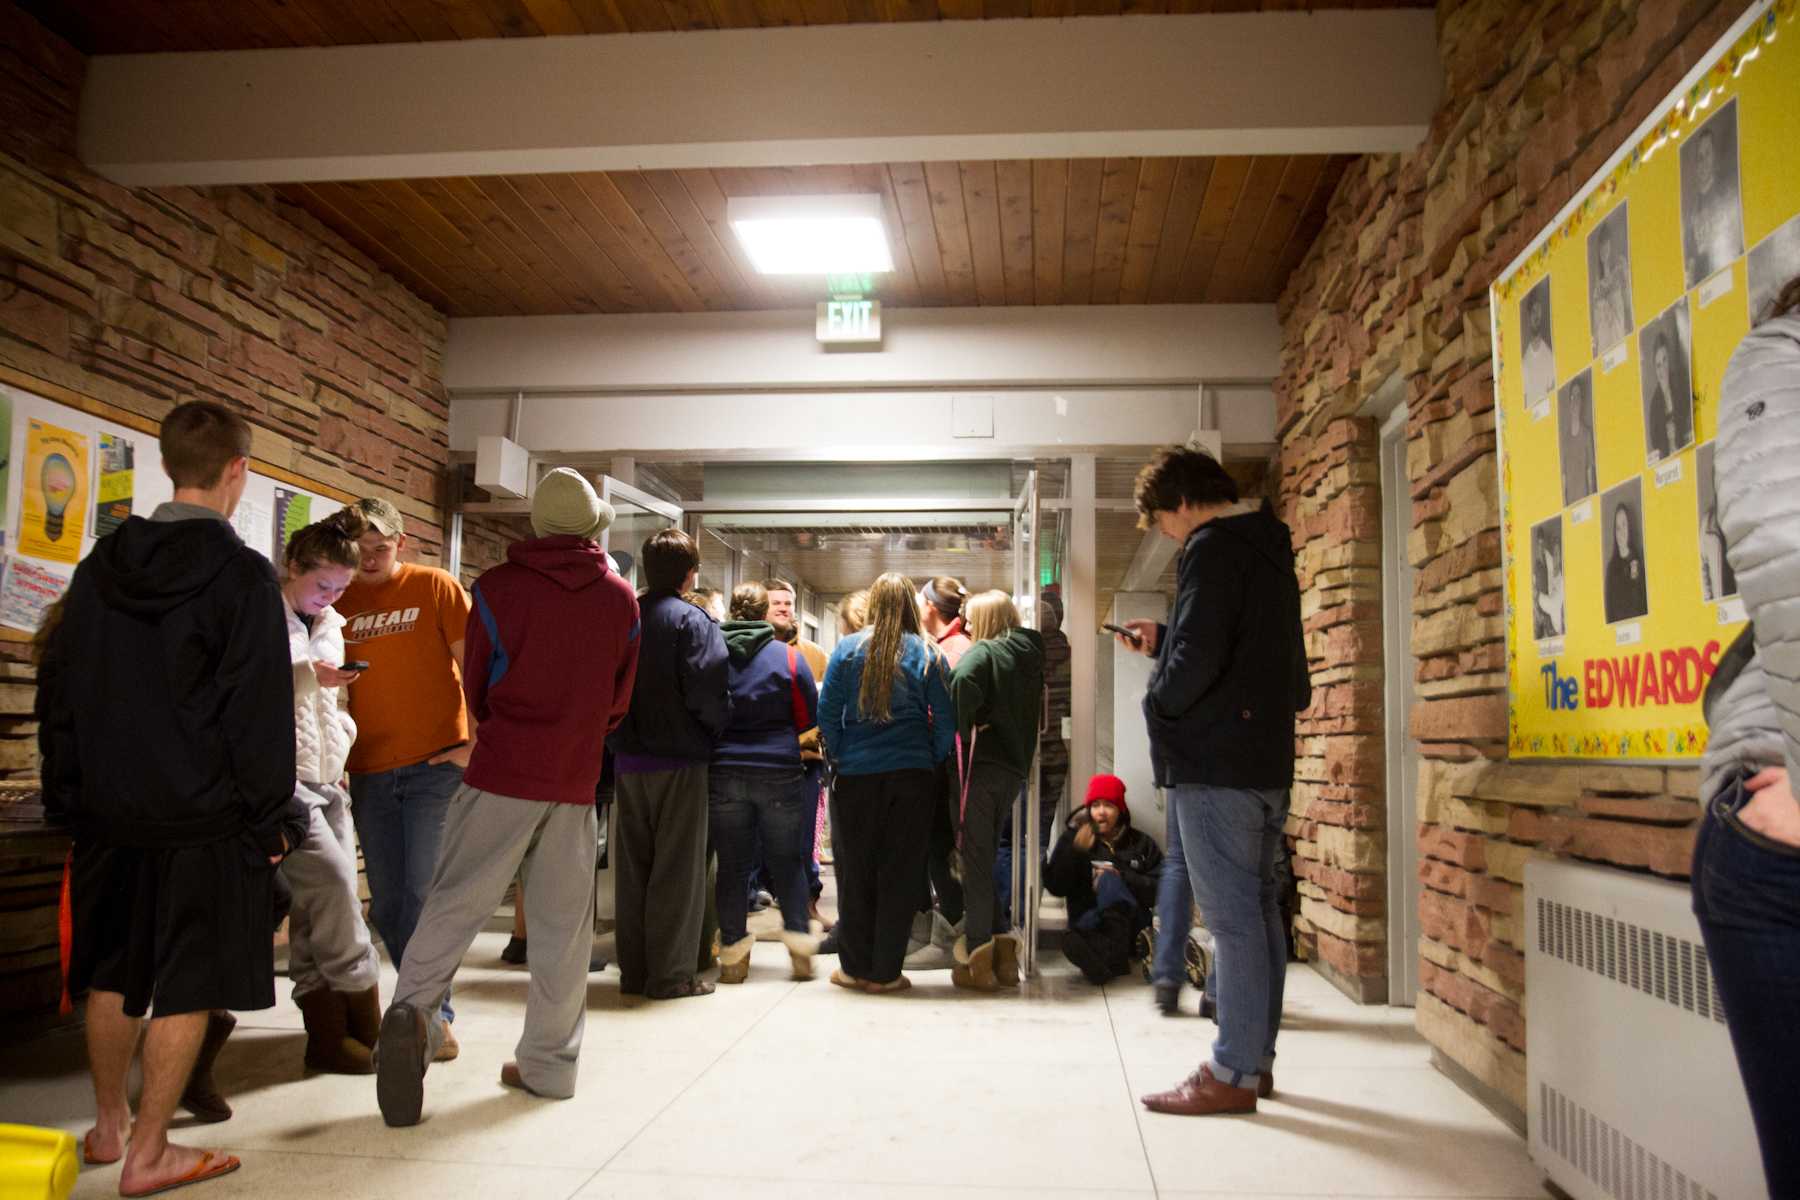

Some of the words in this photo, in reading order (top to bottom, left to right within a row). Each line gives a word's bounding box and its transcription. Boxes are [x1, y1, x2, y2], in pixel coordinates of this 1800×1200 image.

[828, 301, 872, 332] EXIT
[352, 607, 420, 632] MEAD
[1541, 660, 1578, 710] The
